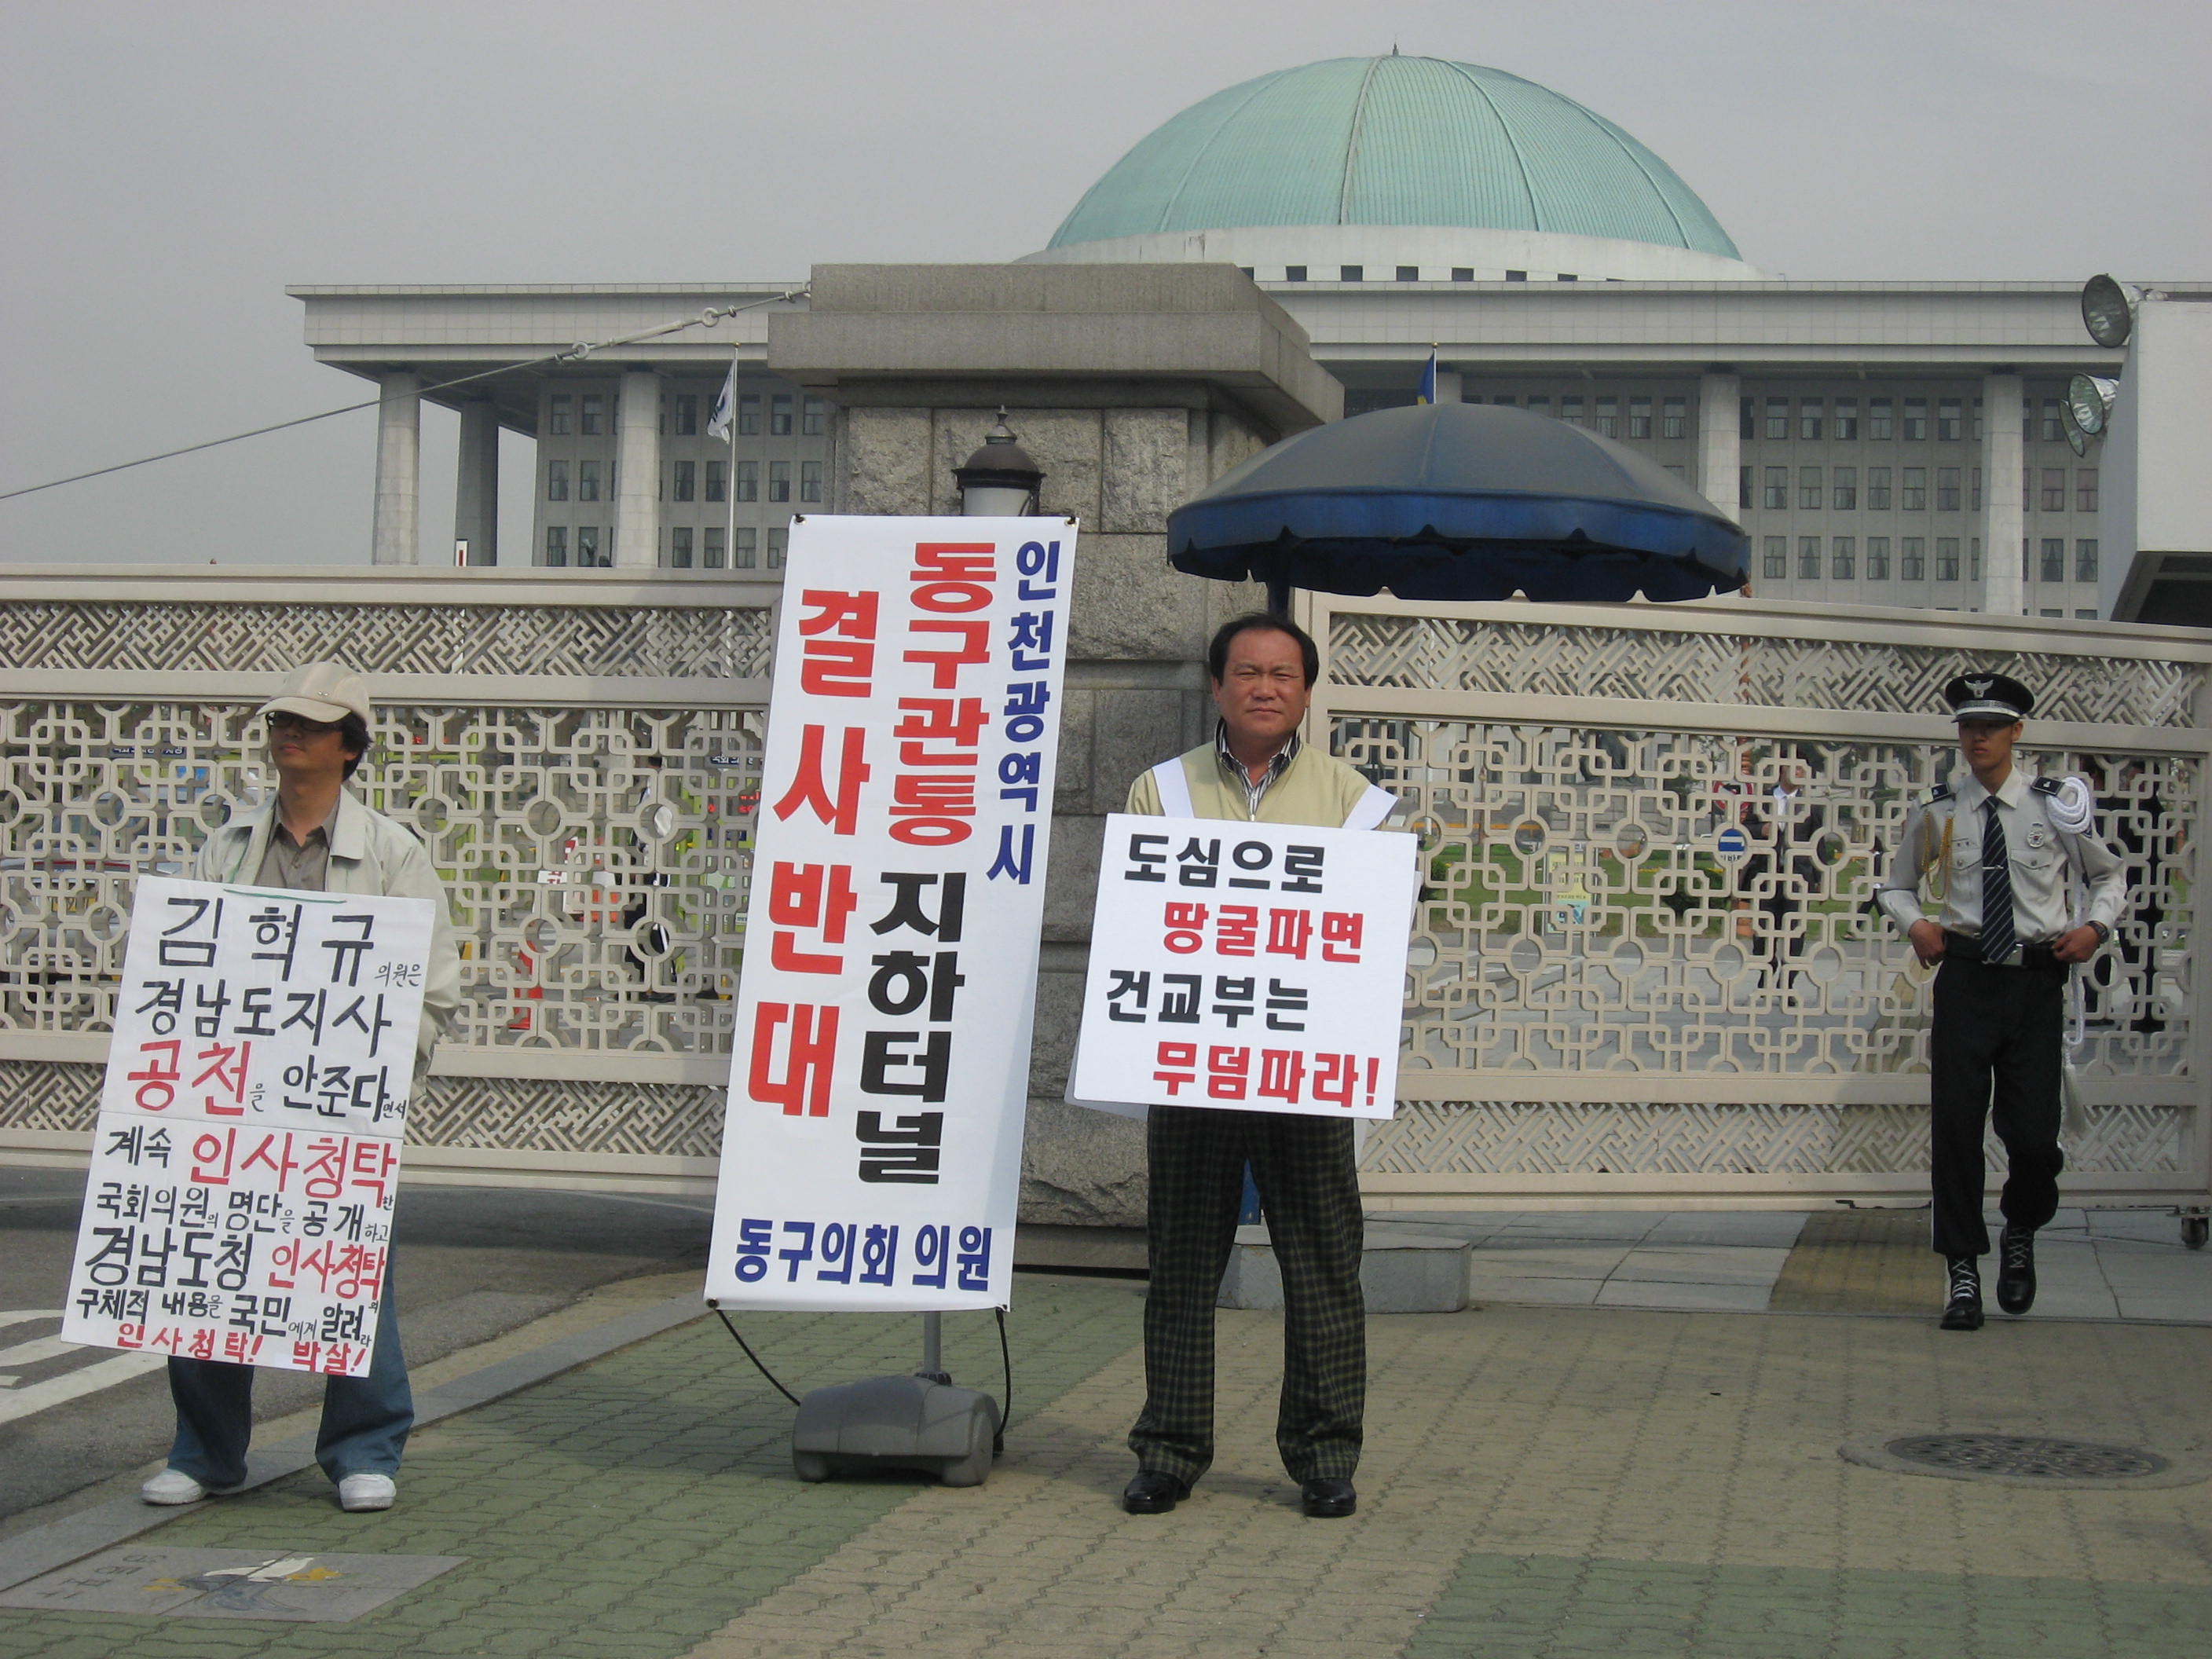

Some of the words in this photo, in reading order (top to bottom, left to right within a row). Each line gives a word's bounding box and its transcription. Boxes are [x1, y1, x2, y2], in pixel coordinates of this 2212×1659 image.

[985, 538, 1063, 887] 인천광역시
[1124, 833, 1325, 894] 도심으로
[1163, 901, 1364, 964] 땅굴파면
[134, 978, 393, 1059] 경남도지사
[1105, 969, 1309, 1032] 건교부는
[1152, 1040, 1380, 1108] 무덤파라!
[104, 1124, 173, 1169] 계속
[84, 1225, 254, 1291] 경남도청
[734, 1216, 900, 1290] 동구의회
[910, 1221, 994, 1294] 의원
[76, 1287, 151, 1324] 구체적
[291, 1340, 367, 1376] 박살!
